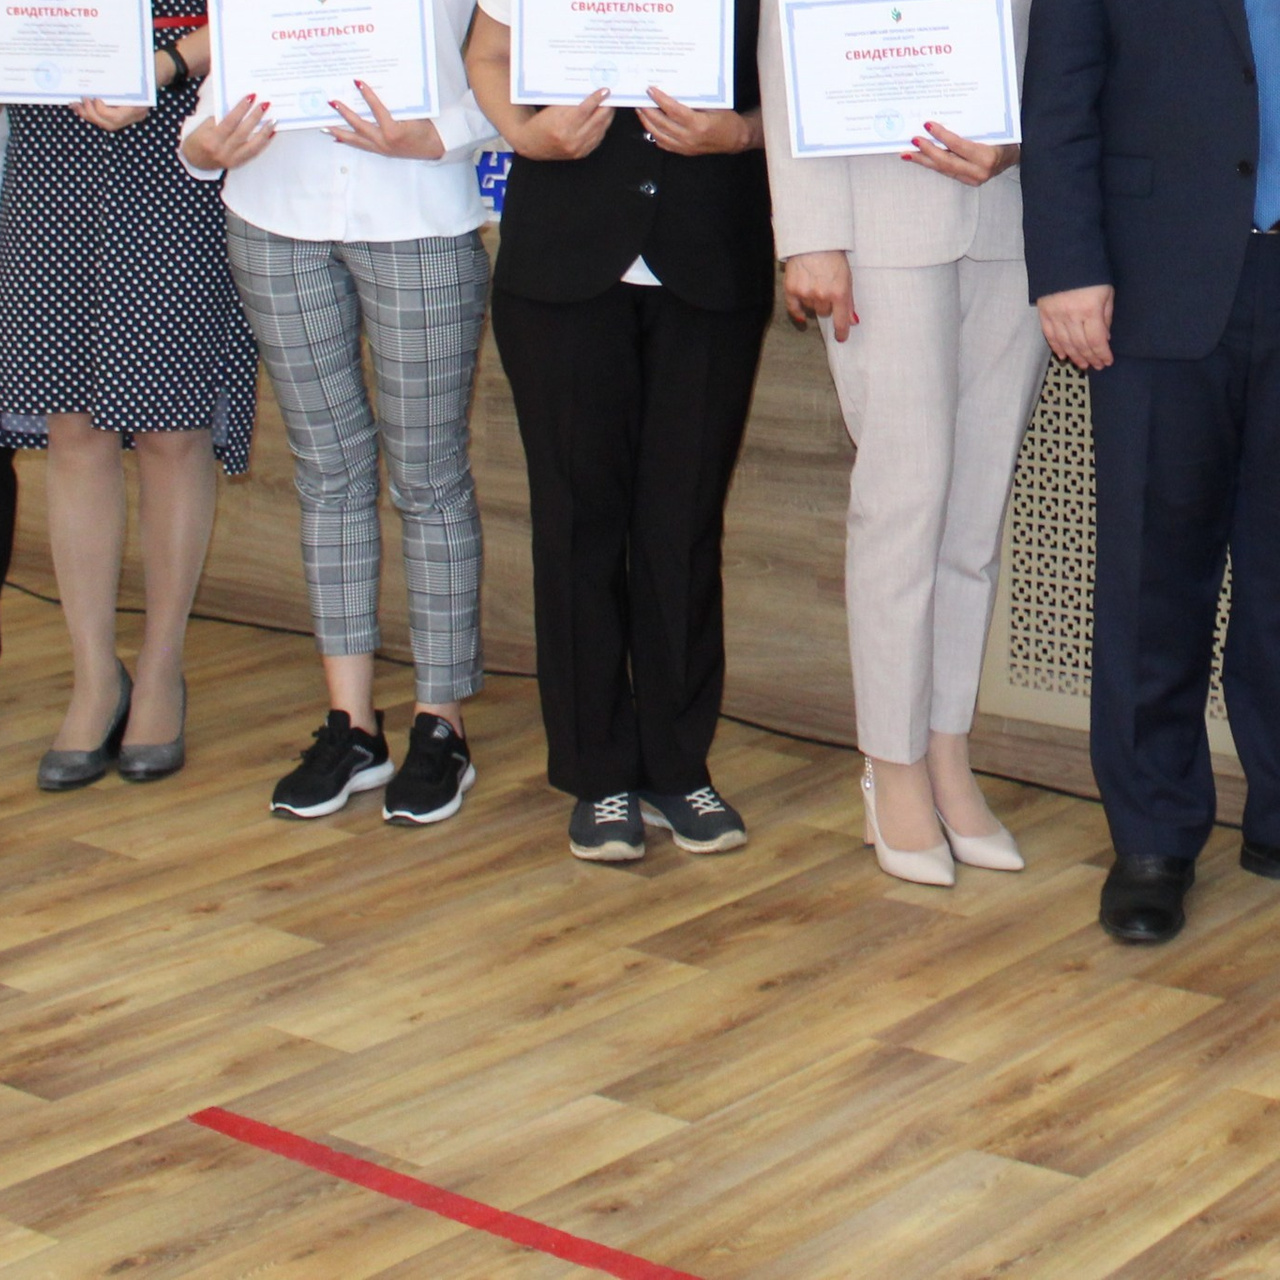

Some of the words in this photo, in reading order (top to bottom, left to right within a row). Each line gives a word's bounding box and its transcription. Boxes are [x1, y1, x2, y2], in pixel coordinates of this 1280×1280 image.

[6, 6, 99, 18] СВИДЕТЕЛЬСТВО
[571, 1, 674, 14] СВИДЕТЕЛЬСТВО
[272, 23, 375, 41] СВИДЕТЕЛЬСТВО
[845, 44, 953, 61] СВИДЕТЕЛЬСТВО
